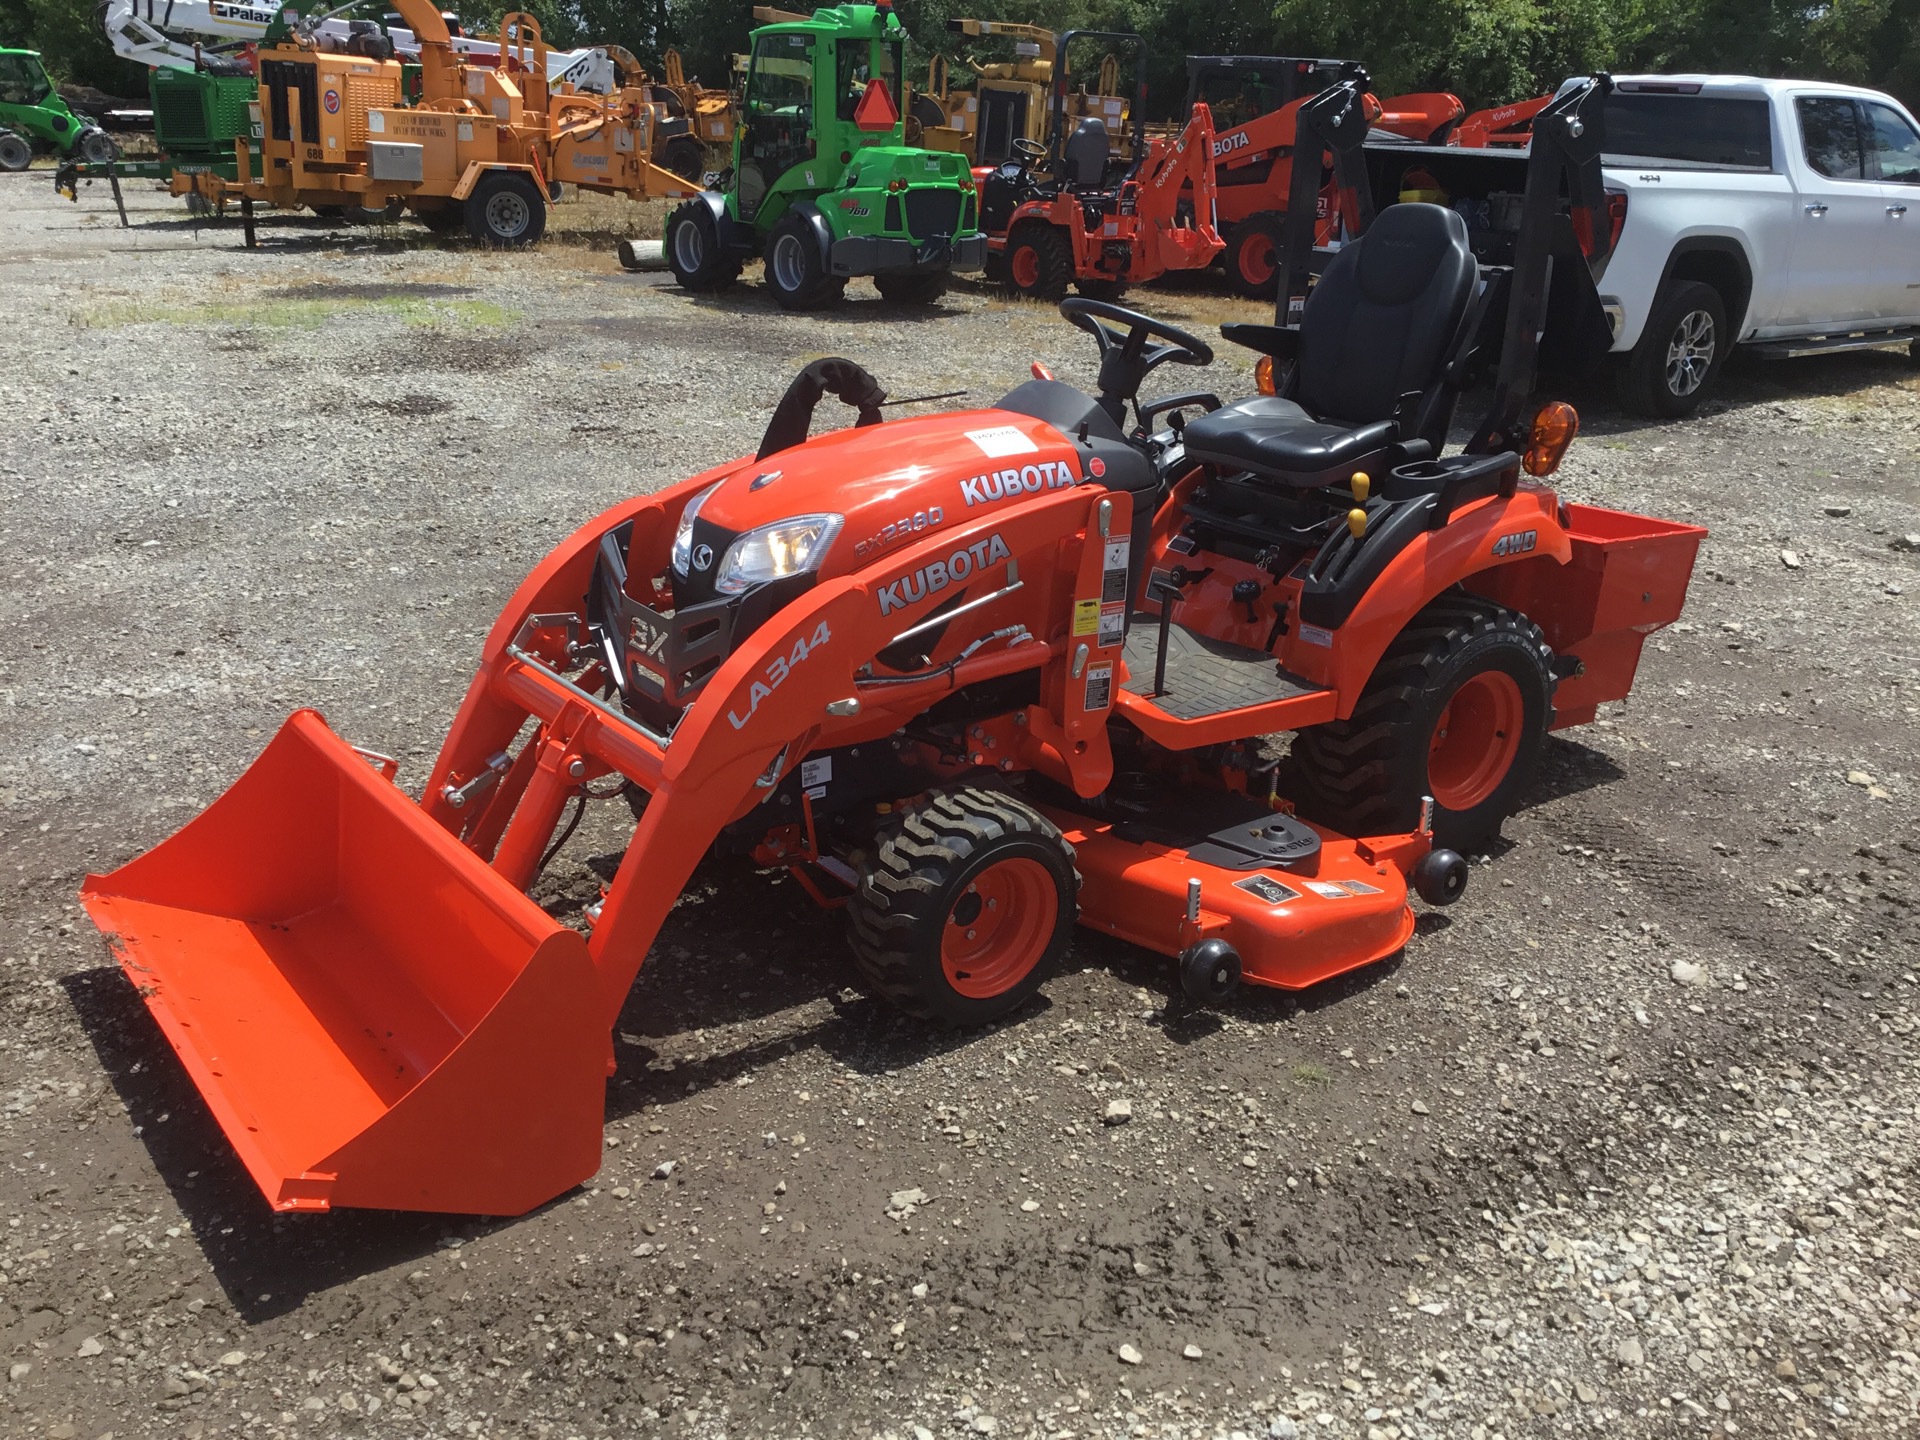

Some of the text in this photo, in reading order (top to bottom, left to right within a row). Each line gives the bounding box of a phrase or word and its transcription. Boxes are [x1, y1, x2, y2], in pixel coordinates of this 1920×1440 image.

[398, 115, 409, 125] CITY
[410, 115, 417, 125] OF
[1493, 108, 1516, 121] Kubota
[411, 127, 427, 136] PUBLIC
[430, 127, 447, 137] WORKS
[307, 148, 324, 159] 688
[1155, 159, 1177, 188] Kubota
[850, 207, 869, 216] 760
[959, 460, 1077, 507] KUBOTA
[854, 506, 944, 558] BX2380
[1491, 529, 1537, 557] 4WD
[876, 532, 1013, 617] KUBOTA
[629, 616, 668, 665] BX
[727, 620, 832, 730] LA344
